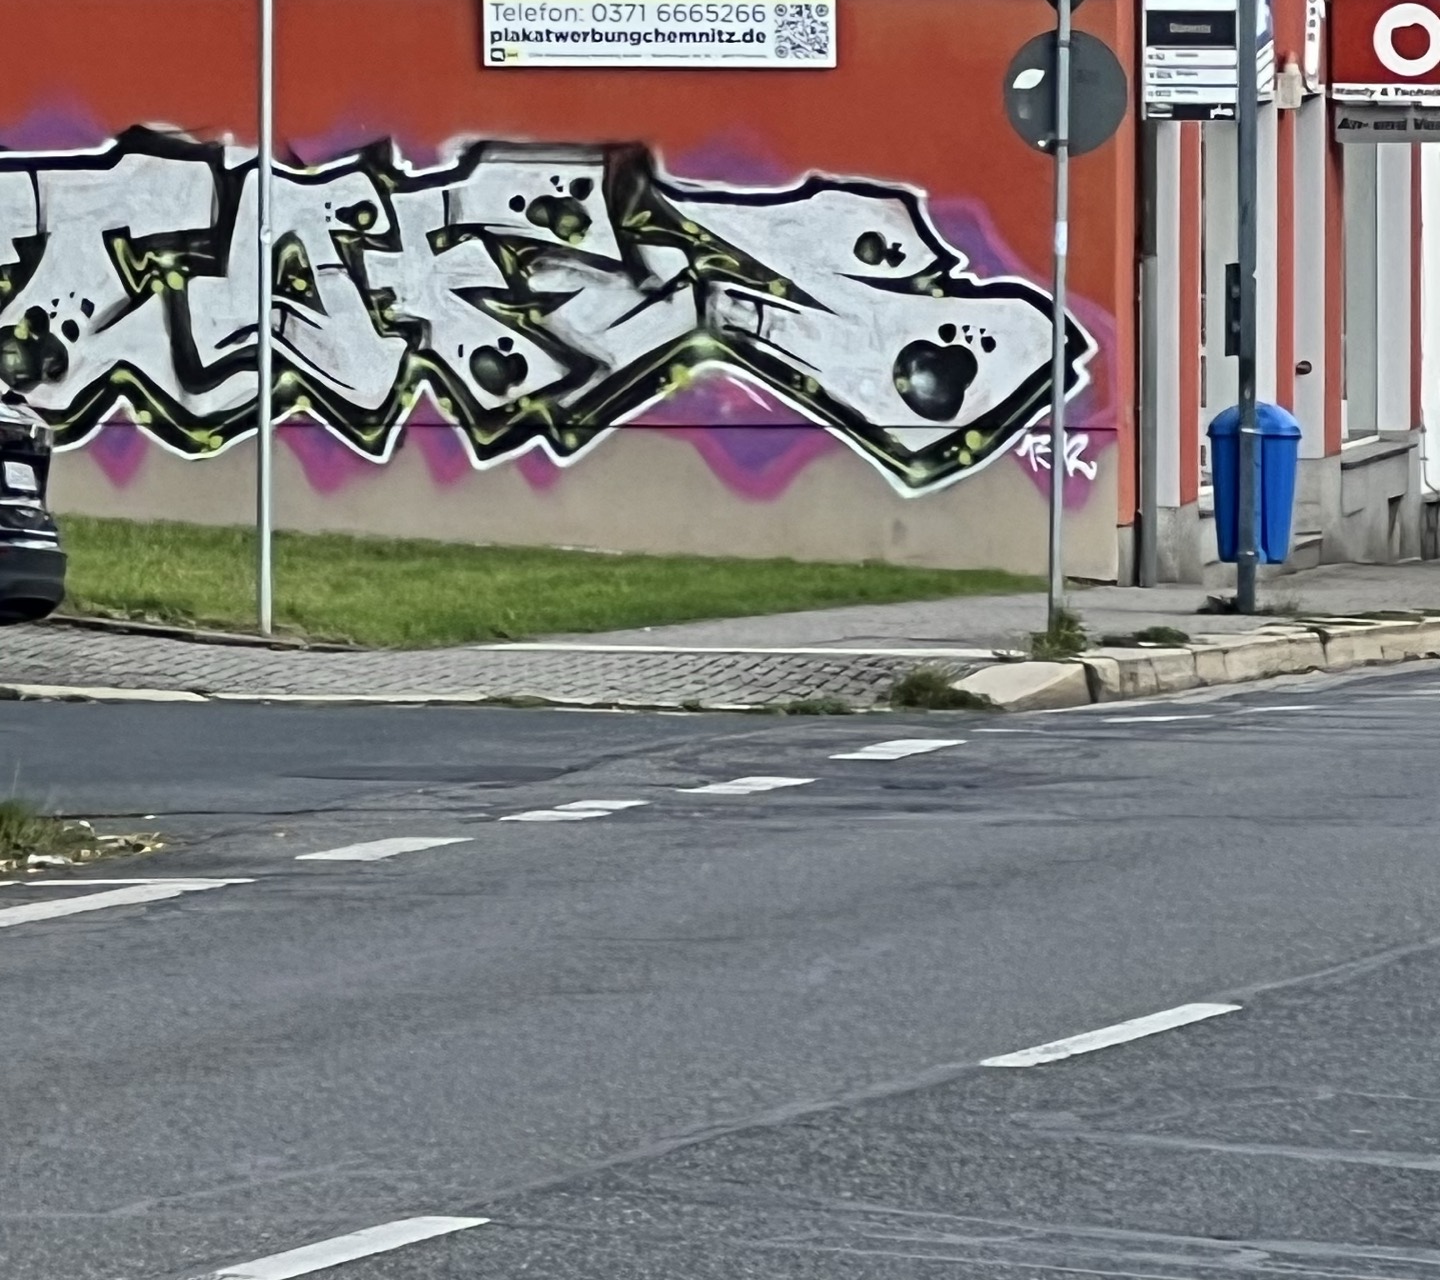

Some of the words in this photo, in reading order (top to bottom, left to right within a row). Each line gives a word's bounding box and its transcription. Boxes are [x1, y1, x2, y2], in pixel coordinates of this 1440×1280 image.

[490, 3, 584, 23] Telefon:
[592, 3, 646, 23] 0371
[656, 3, 766, 23] 6665266
[490, 27, 767, 46] plakatwerbungchemnitz.de
